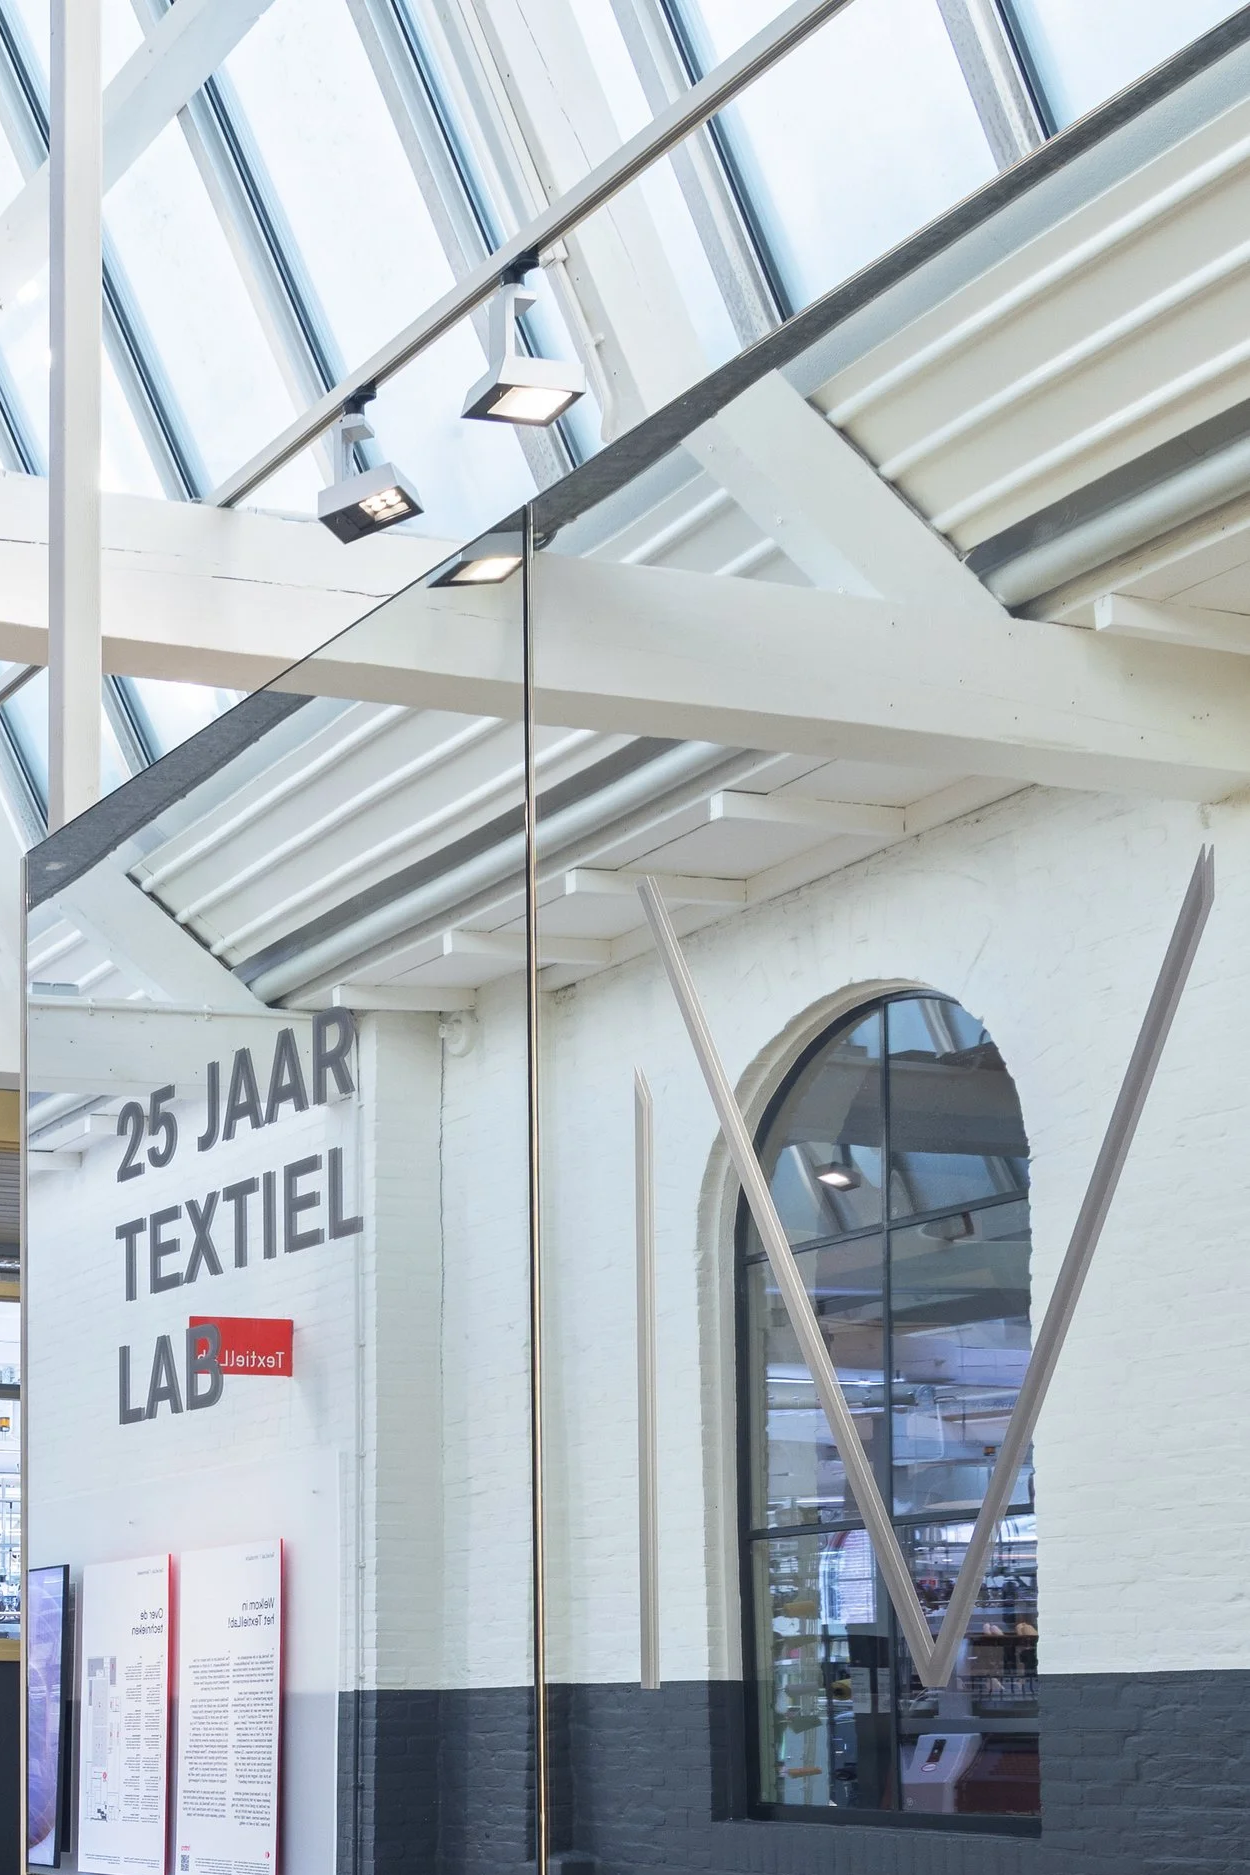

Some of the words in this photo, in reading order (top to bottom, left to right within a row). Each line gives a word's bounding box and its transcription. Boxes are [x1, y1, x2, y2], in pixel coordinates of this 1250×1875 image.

[116, 1084, 178, 1183] 25
[197, 1006, 356, 1152] JAAR
[115, 1146, 364, 1302] TEXTIEL
[118, 1322, 224, 1426] LAB
